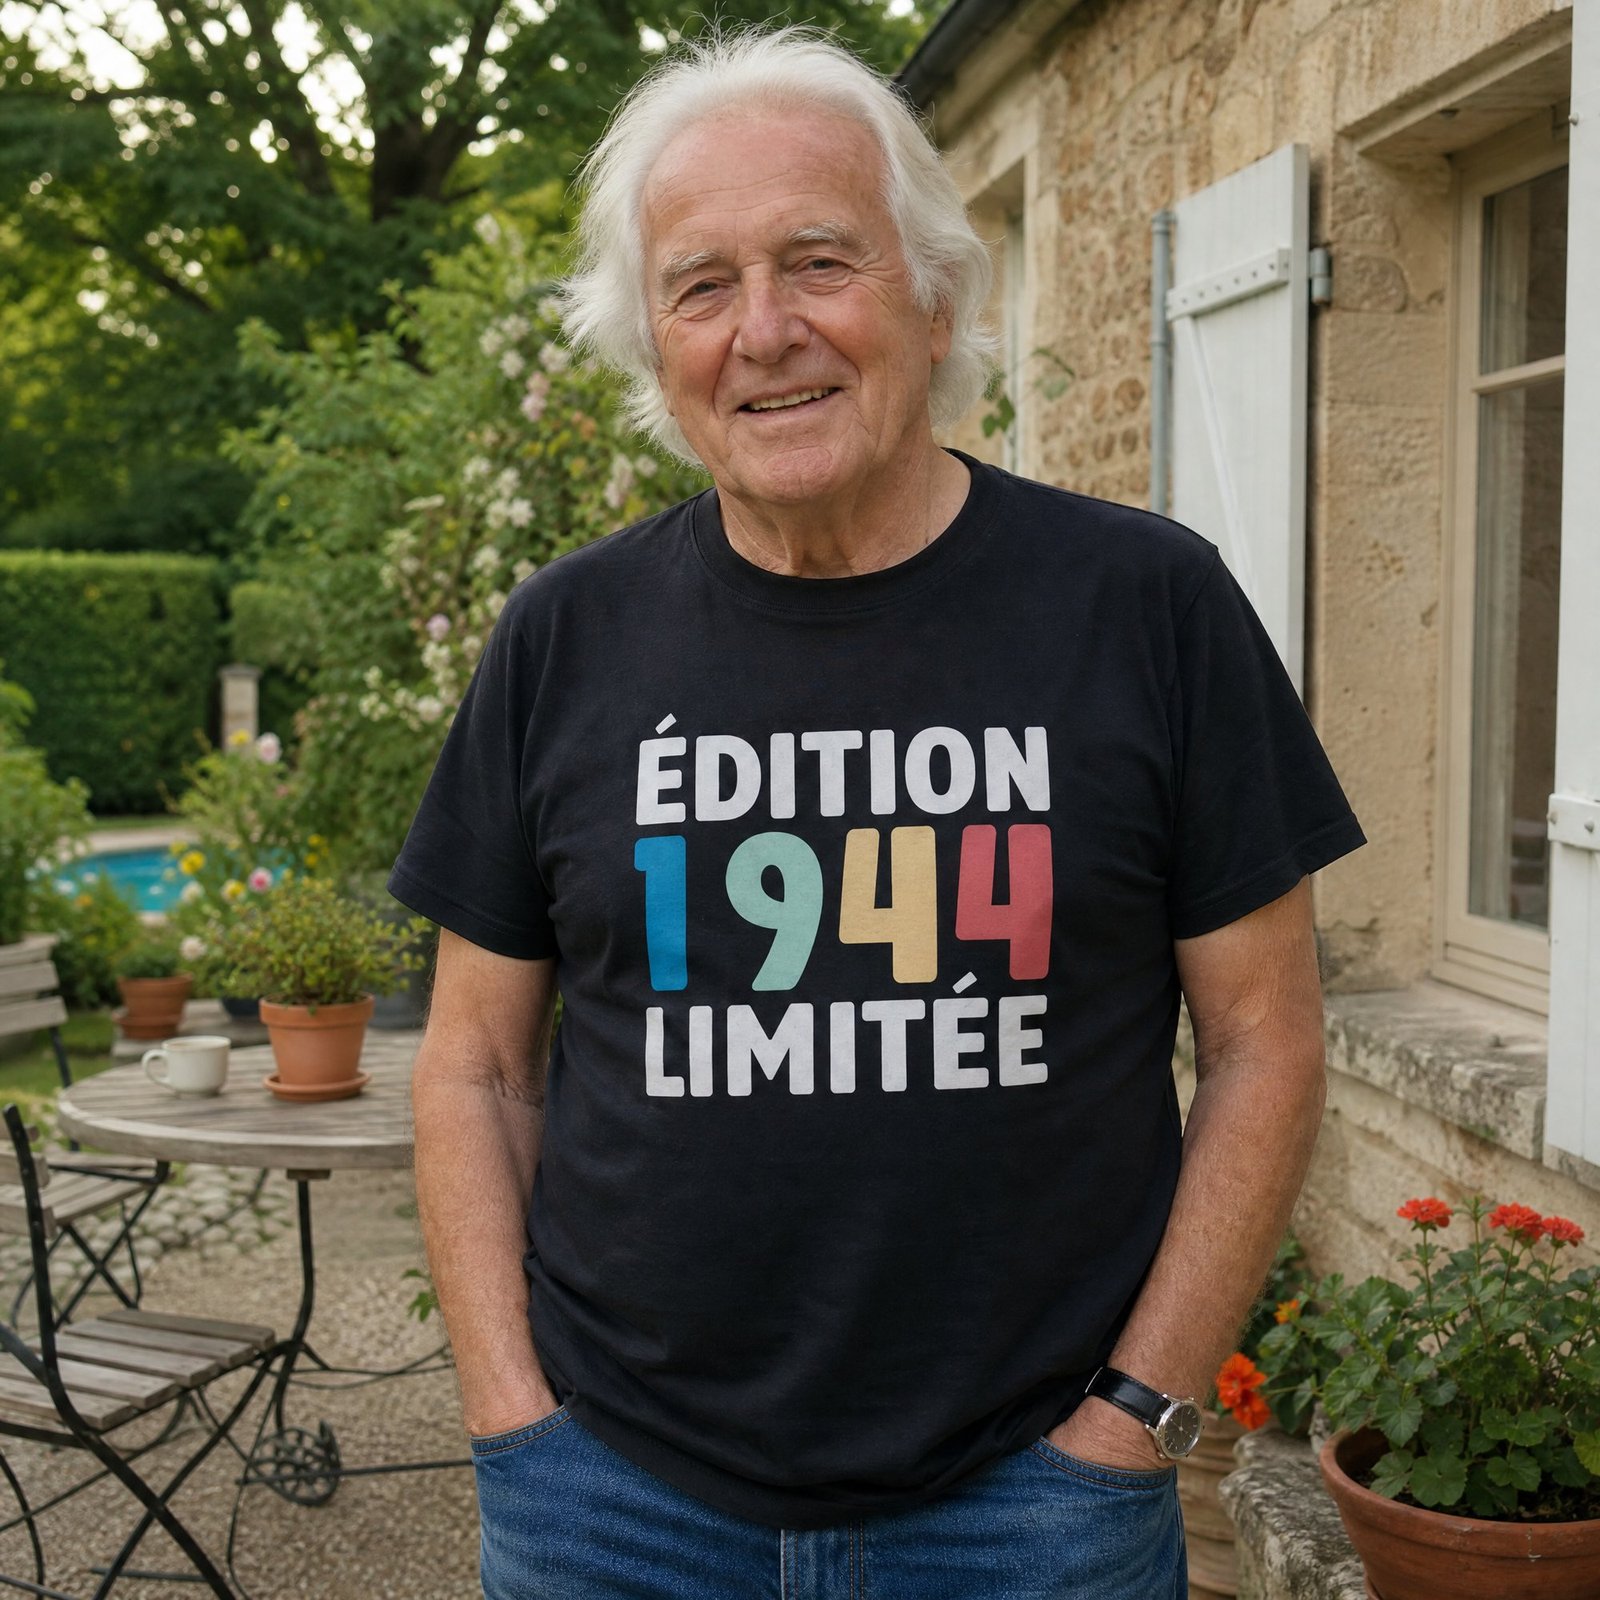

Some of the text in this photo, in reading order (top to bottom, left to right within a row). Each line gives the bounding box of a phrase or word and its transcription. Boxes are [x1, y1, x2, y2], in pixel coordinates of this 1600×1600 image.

[636, 713, 1050, 825] ÉDITION
[634, 824, 1053, 991] 1944
[645, 972, 1048, 1097] LIMITÉE
